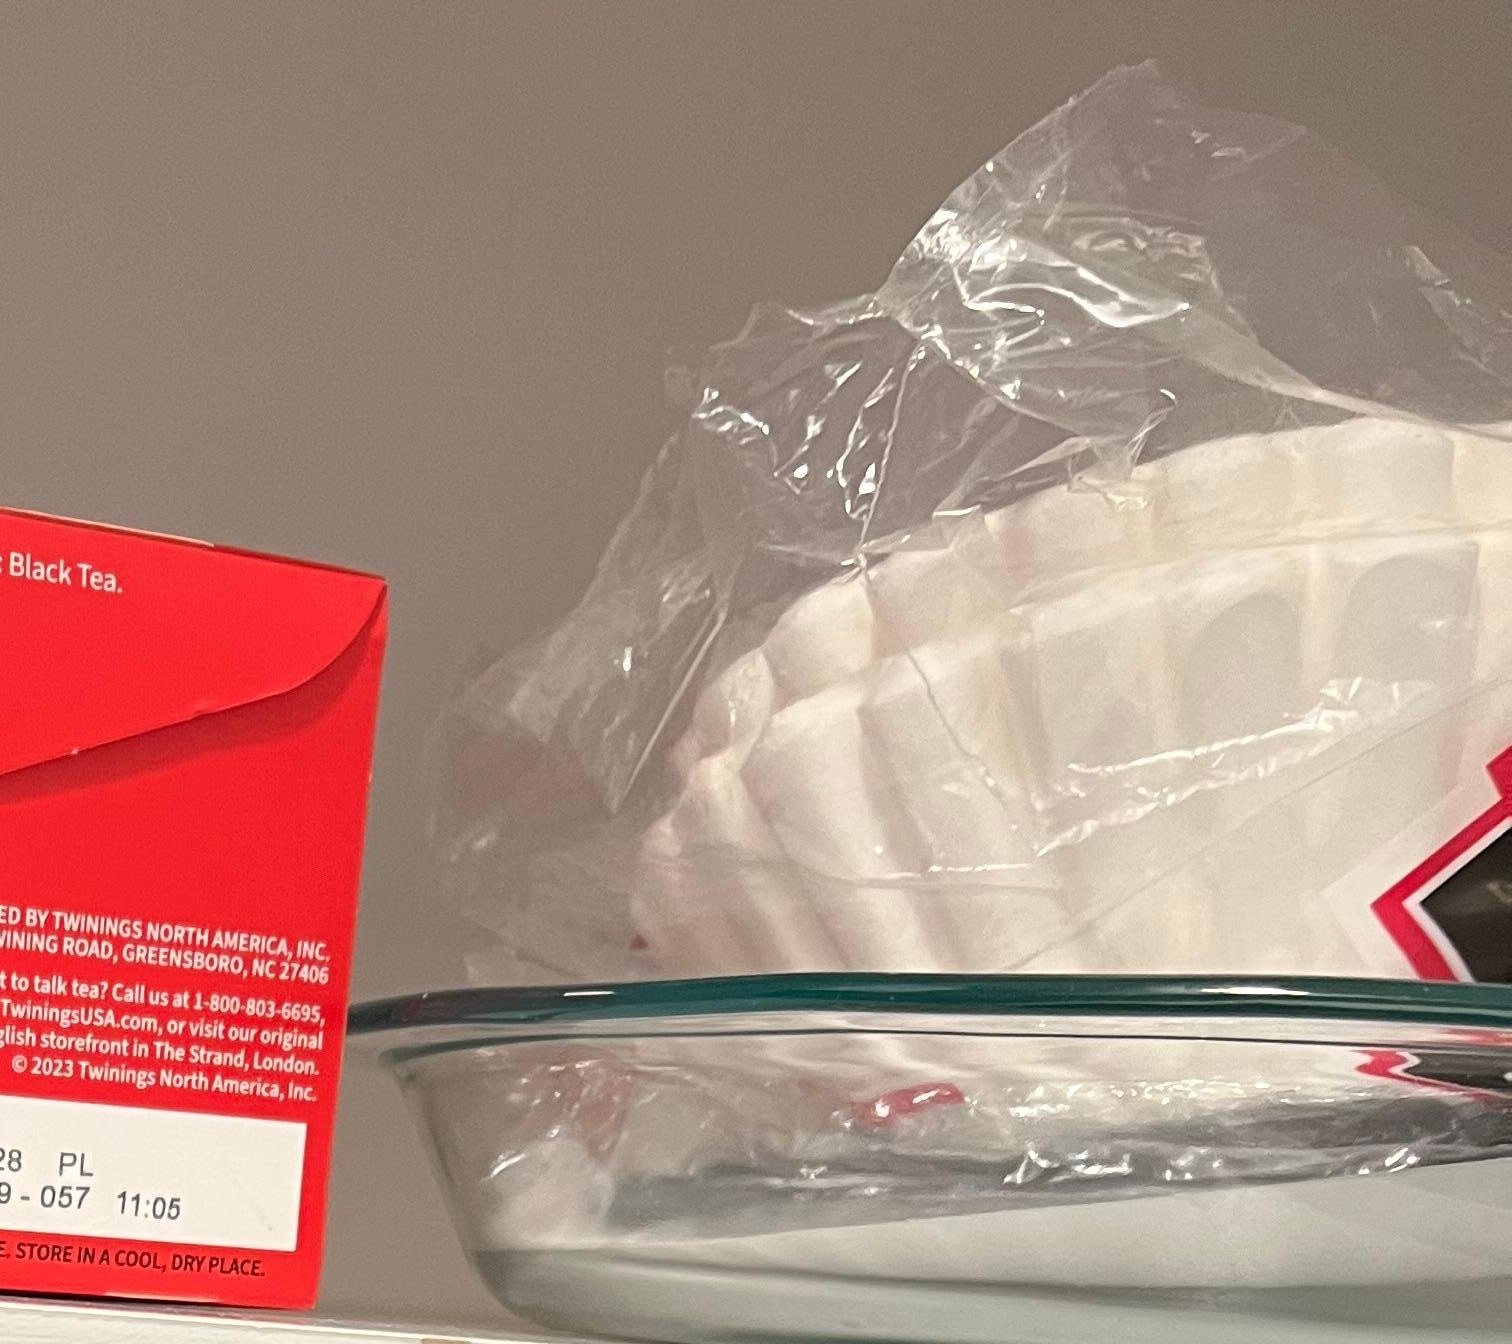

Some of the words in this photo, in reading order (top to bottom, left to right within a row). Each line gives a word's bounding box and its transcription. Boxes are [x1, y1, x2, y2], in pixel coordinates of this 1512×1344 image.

[9, 552, 72, 586] Black
[77, 563, 123, 594] Tea.
[25, 908, 50, 928] BY
[53, 911, 143, 940] TWININGS
[146, 922, 209, 948] NORTH
[211, 930, 293, 961] AMERICA,
[296, 940, 330, 962] INC.
[63, 937, 118, 964] ROAD,
[122, 943, 248, 979] GREENSBORO,
[252, 958, 276, 979] NC
[279, 961, 329, 985] 27406
[10, 972, 29, 992] to
[33, 975, 68, 996] talk
[71, 979, 108, 999] tea?
[111, 983, 145, 1004] Call
[149, 990, 169, 1006] us
[172, 991, 189, 1009] at
[193, 992, 326, 1028] 1-800-803-6695,
[0, 998, 163, 1036] TwiningsUSA.com,
[166, 1019, 185, 1035] or
[189, 1018, 224, 1040] visit
[228, 1025, 257, 1042] our
[260, 1027, 324, 1051] original
[40, 1030, 129, 1057] storefront
[133, 1038, 149, 1057] in
[153, 1041, 185, 1062] The
[189, 1045, 249, 1072] Strand,
[253, 1051, 320, 1076] London.
[31, 1056, 74, 1078] 2023
[78, 1060, 156, 1089] Twinings
[160, 1068, 209, 1091] North
[211, 1074, 285, 1102] America,
[287, 1082, 317, 1101] Inc.
[58, 1152, 94, 1178] PL
[40, 1184, 91, 1211] 057
[117, 1191, 182, 1221] 11:05
[15, 1242, 73, 1264] STORE
[77, 1246, 96, 1264] IN
[99, 1248, 111, 1266] A
[115, 1249, 168, 1273] COOL,
[171, 1253, 206, 1273] DRY
[208, 1256, 266, 1277] PLACE.
